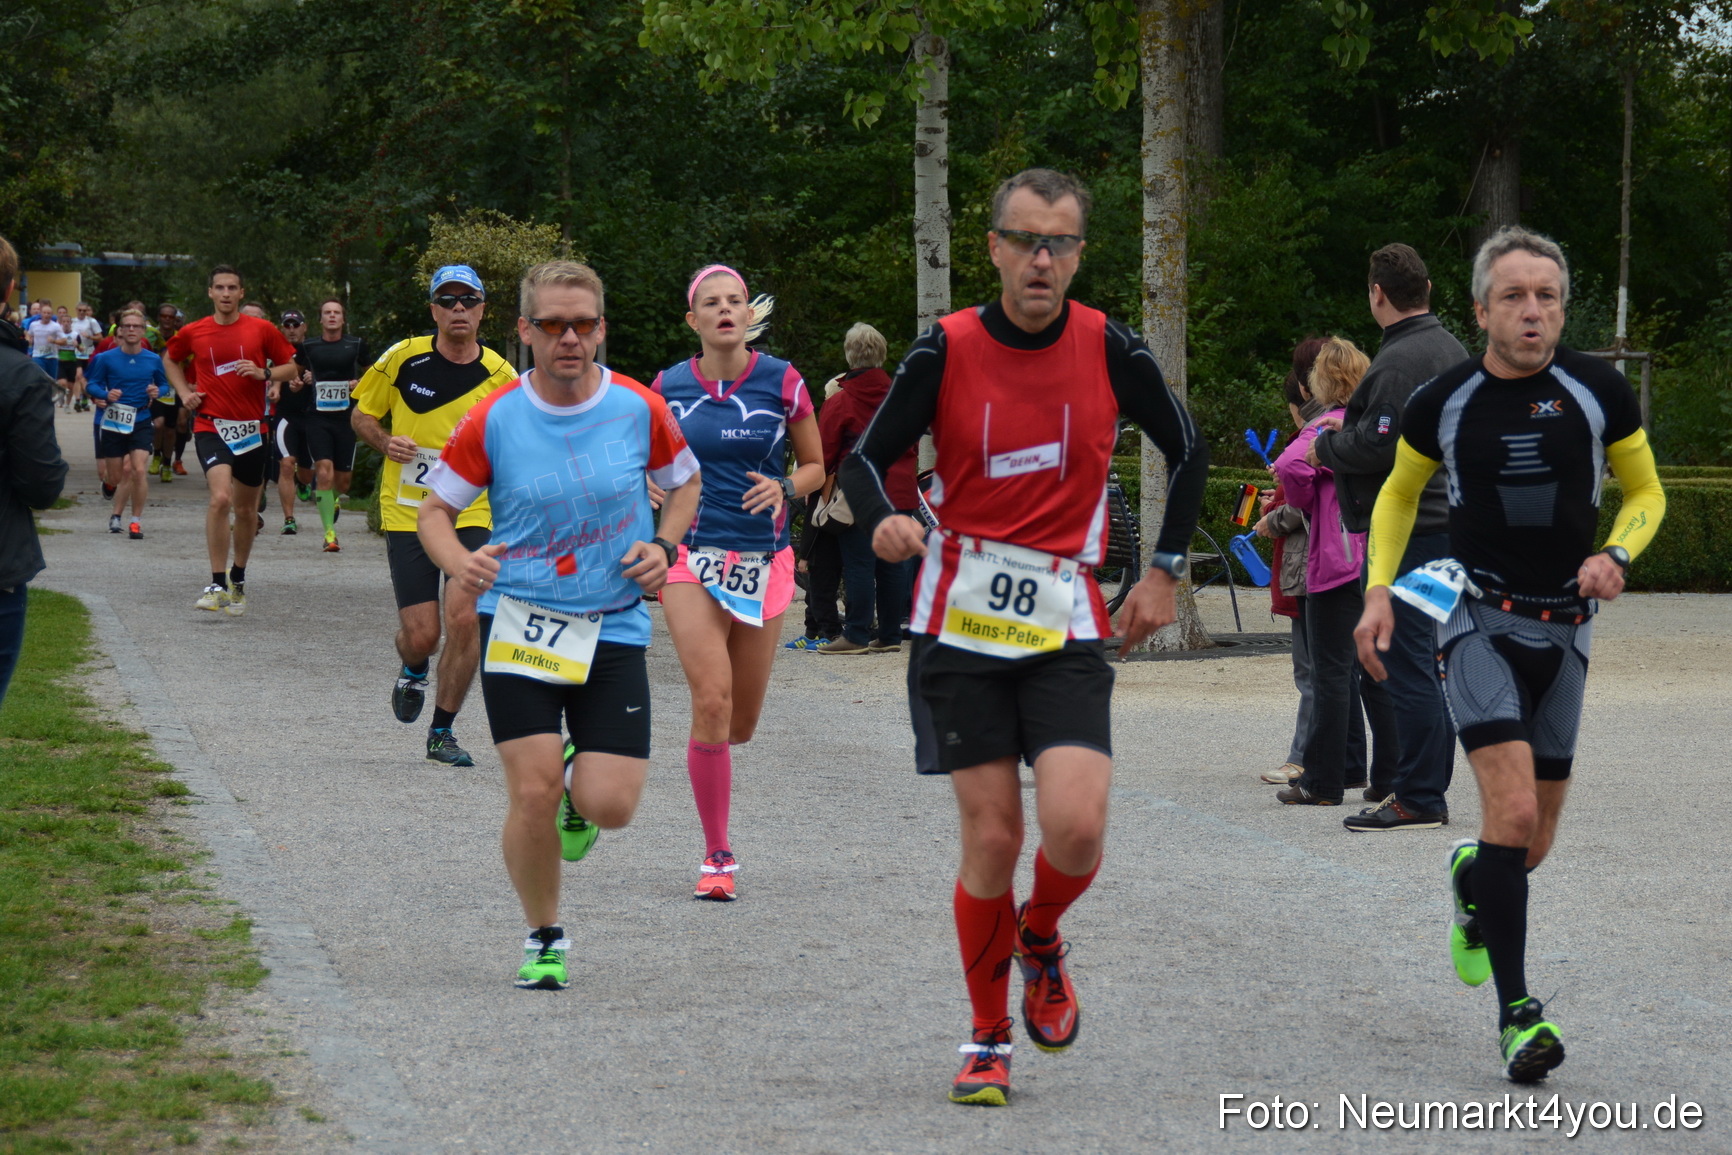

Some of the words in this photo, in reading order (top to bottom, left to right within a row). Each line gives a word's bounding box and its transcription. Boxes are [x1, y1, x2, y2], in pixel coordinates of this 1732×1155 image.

[320, 388, 347, 400] 2476
[410, 383, 436, 397] Peter
[107, 408, 133, 424] 3119
[220, 421, 256, 442] 2335
[721, 429, 751, 438] MCM
[1009, 454, 1041, 469] DEHN
[1616, 516, 1640, 543] saucony
[963, 548, 1000, 565] PARTL
[696, 556, 760, 595] 2353
[988, 572, 1038, 617] 98
[523, 612, 570, 648] 57
[961, 616, 1047, 647] Hans-Peter
[511, 648, 561, 672] Markus
